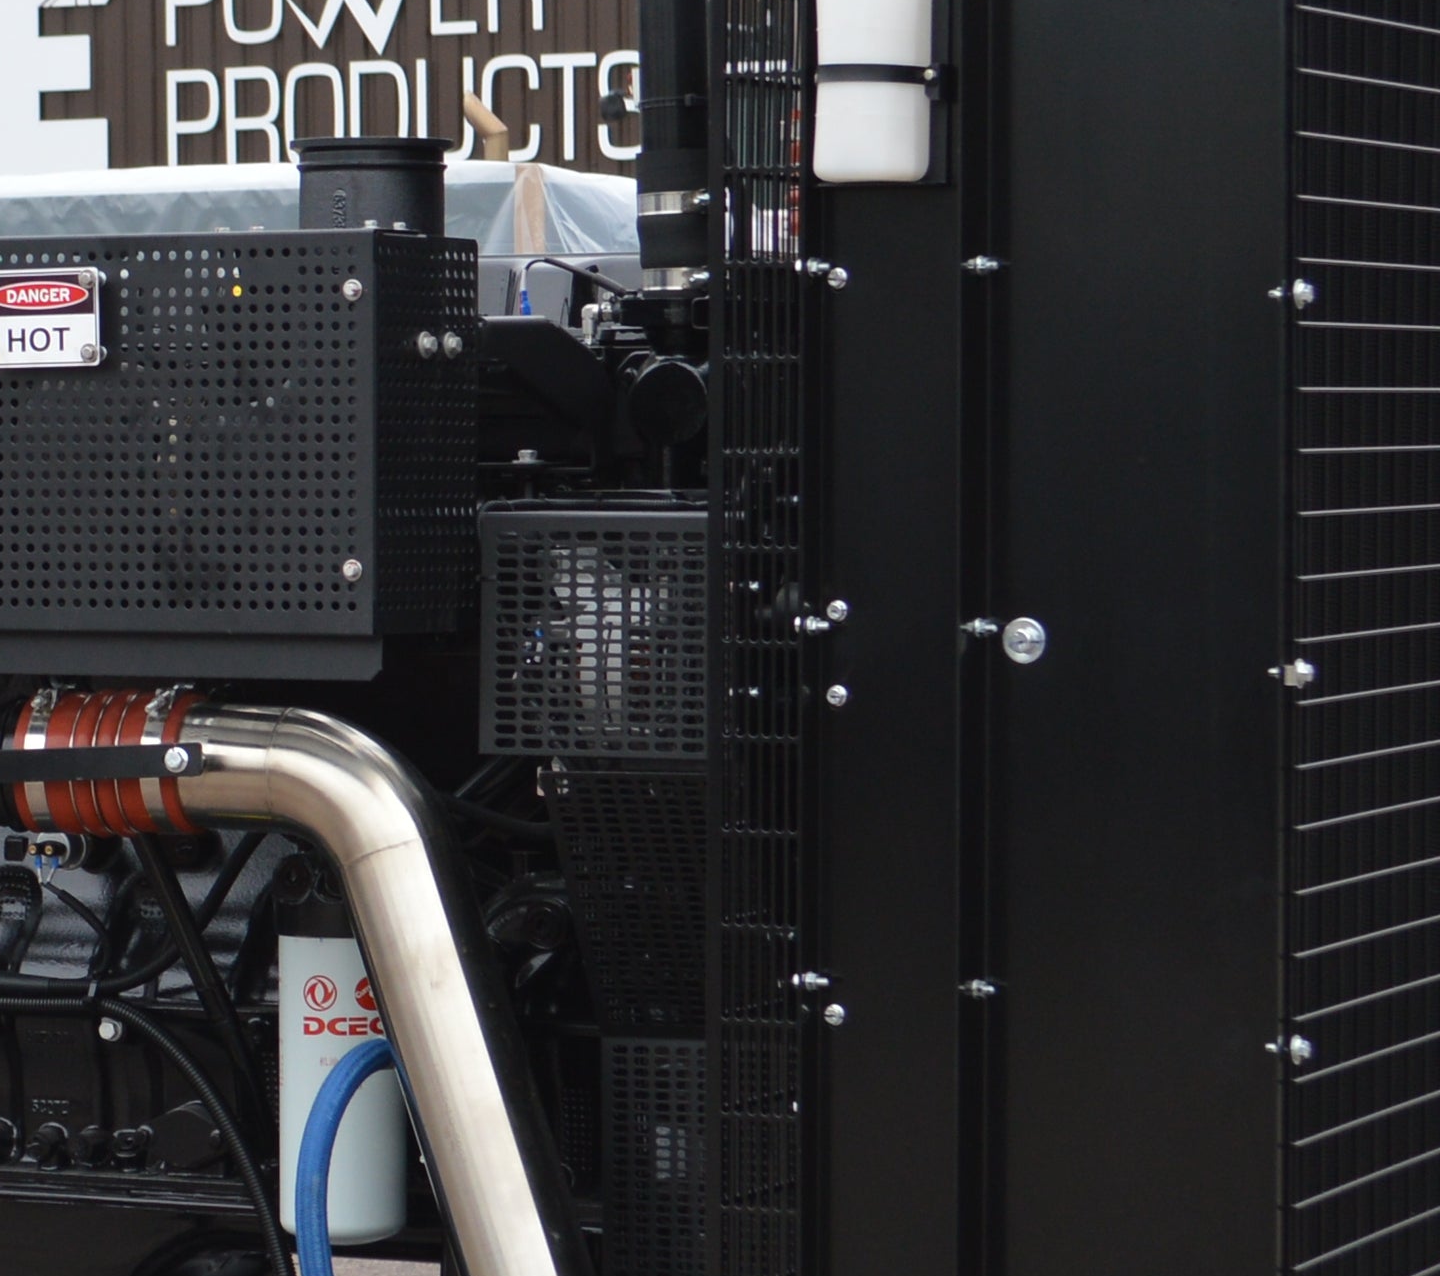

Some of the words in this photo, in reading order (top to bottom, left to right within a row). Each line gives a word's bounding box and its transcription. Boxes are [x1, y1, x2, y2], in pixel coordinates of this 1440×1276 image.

[5, 287, 71, 304] DANGER
[7, 326, 71, 353] HOT
[303, 1016, 384, 1036] DCEC
